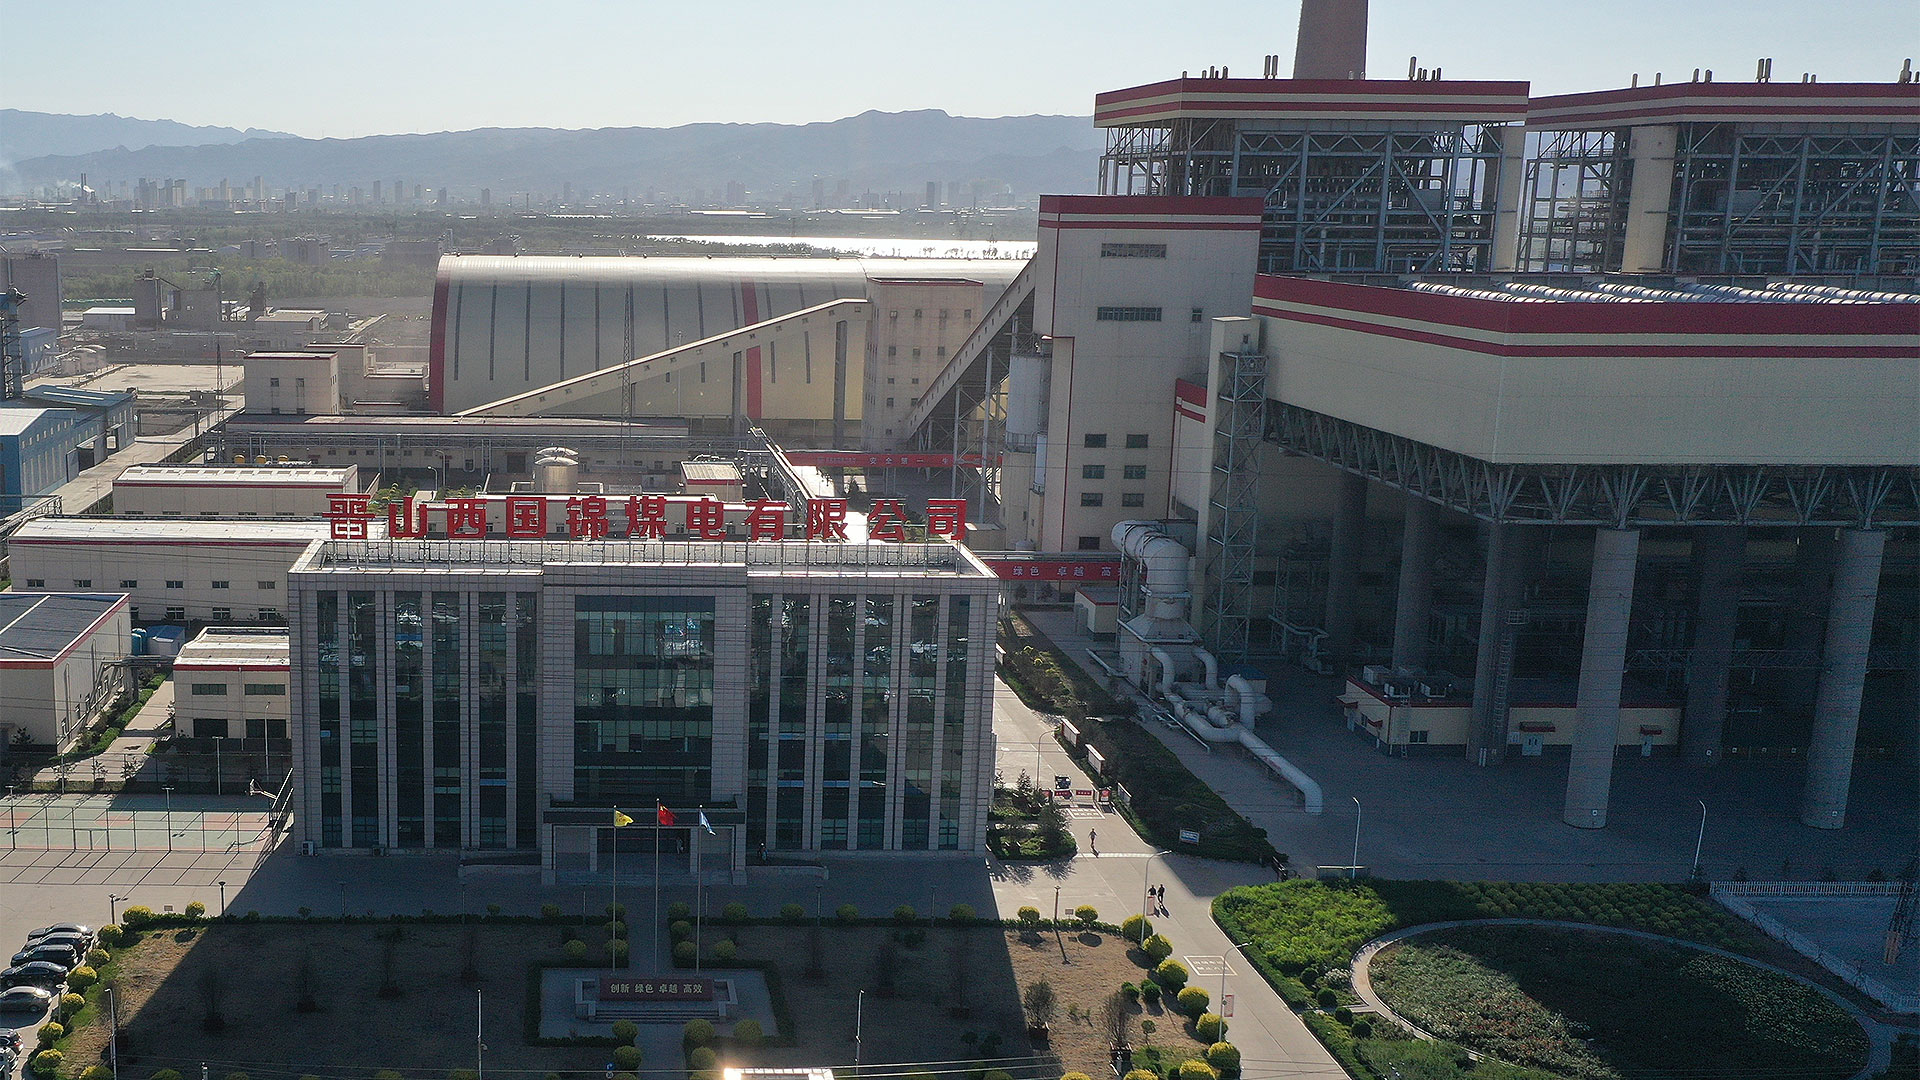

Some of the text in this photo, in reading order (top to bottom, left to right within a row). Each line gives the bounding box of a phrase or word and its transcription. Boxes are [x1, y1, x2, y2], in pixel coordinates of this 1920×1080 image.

[1012, 566, 1122, 577] 绿色 卓越 高
[610, 983, 703, 994] 创新 绿色 卓越 高效
